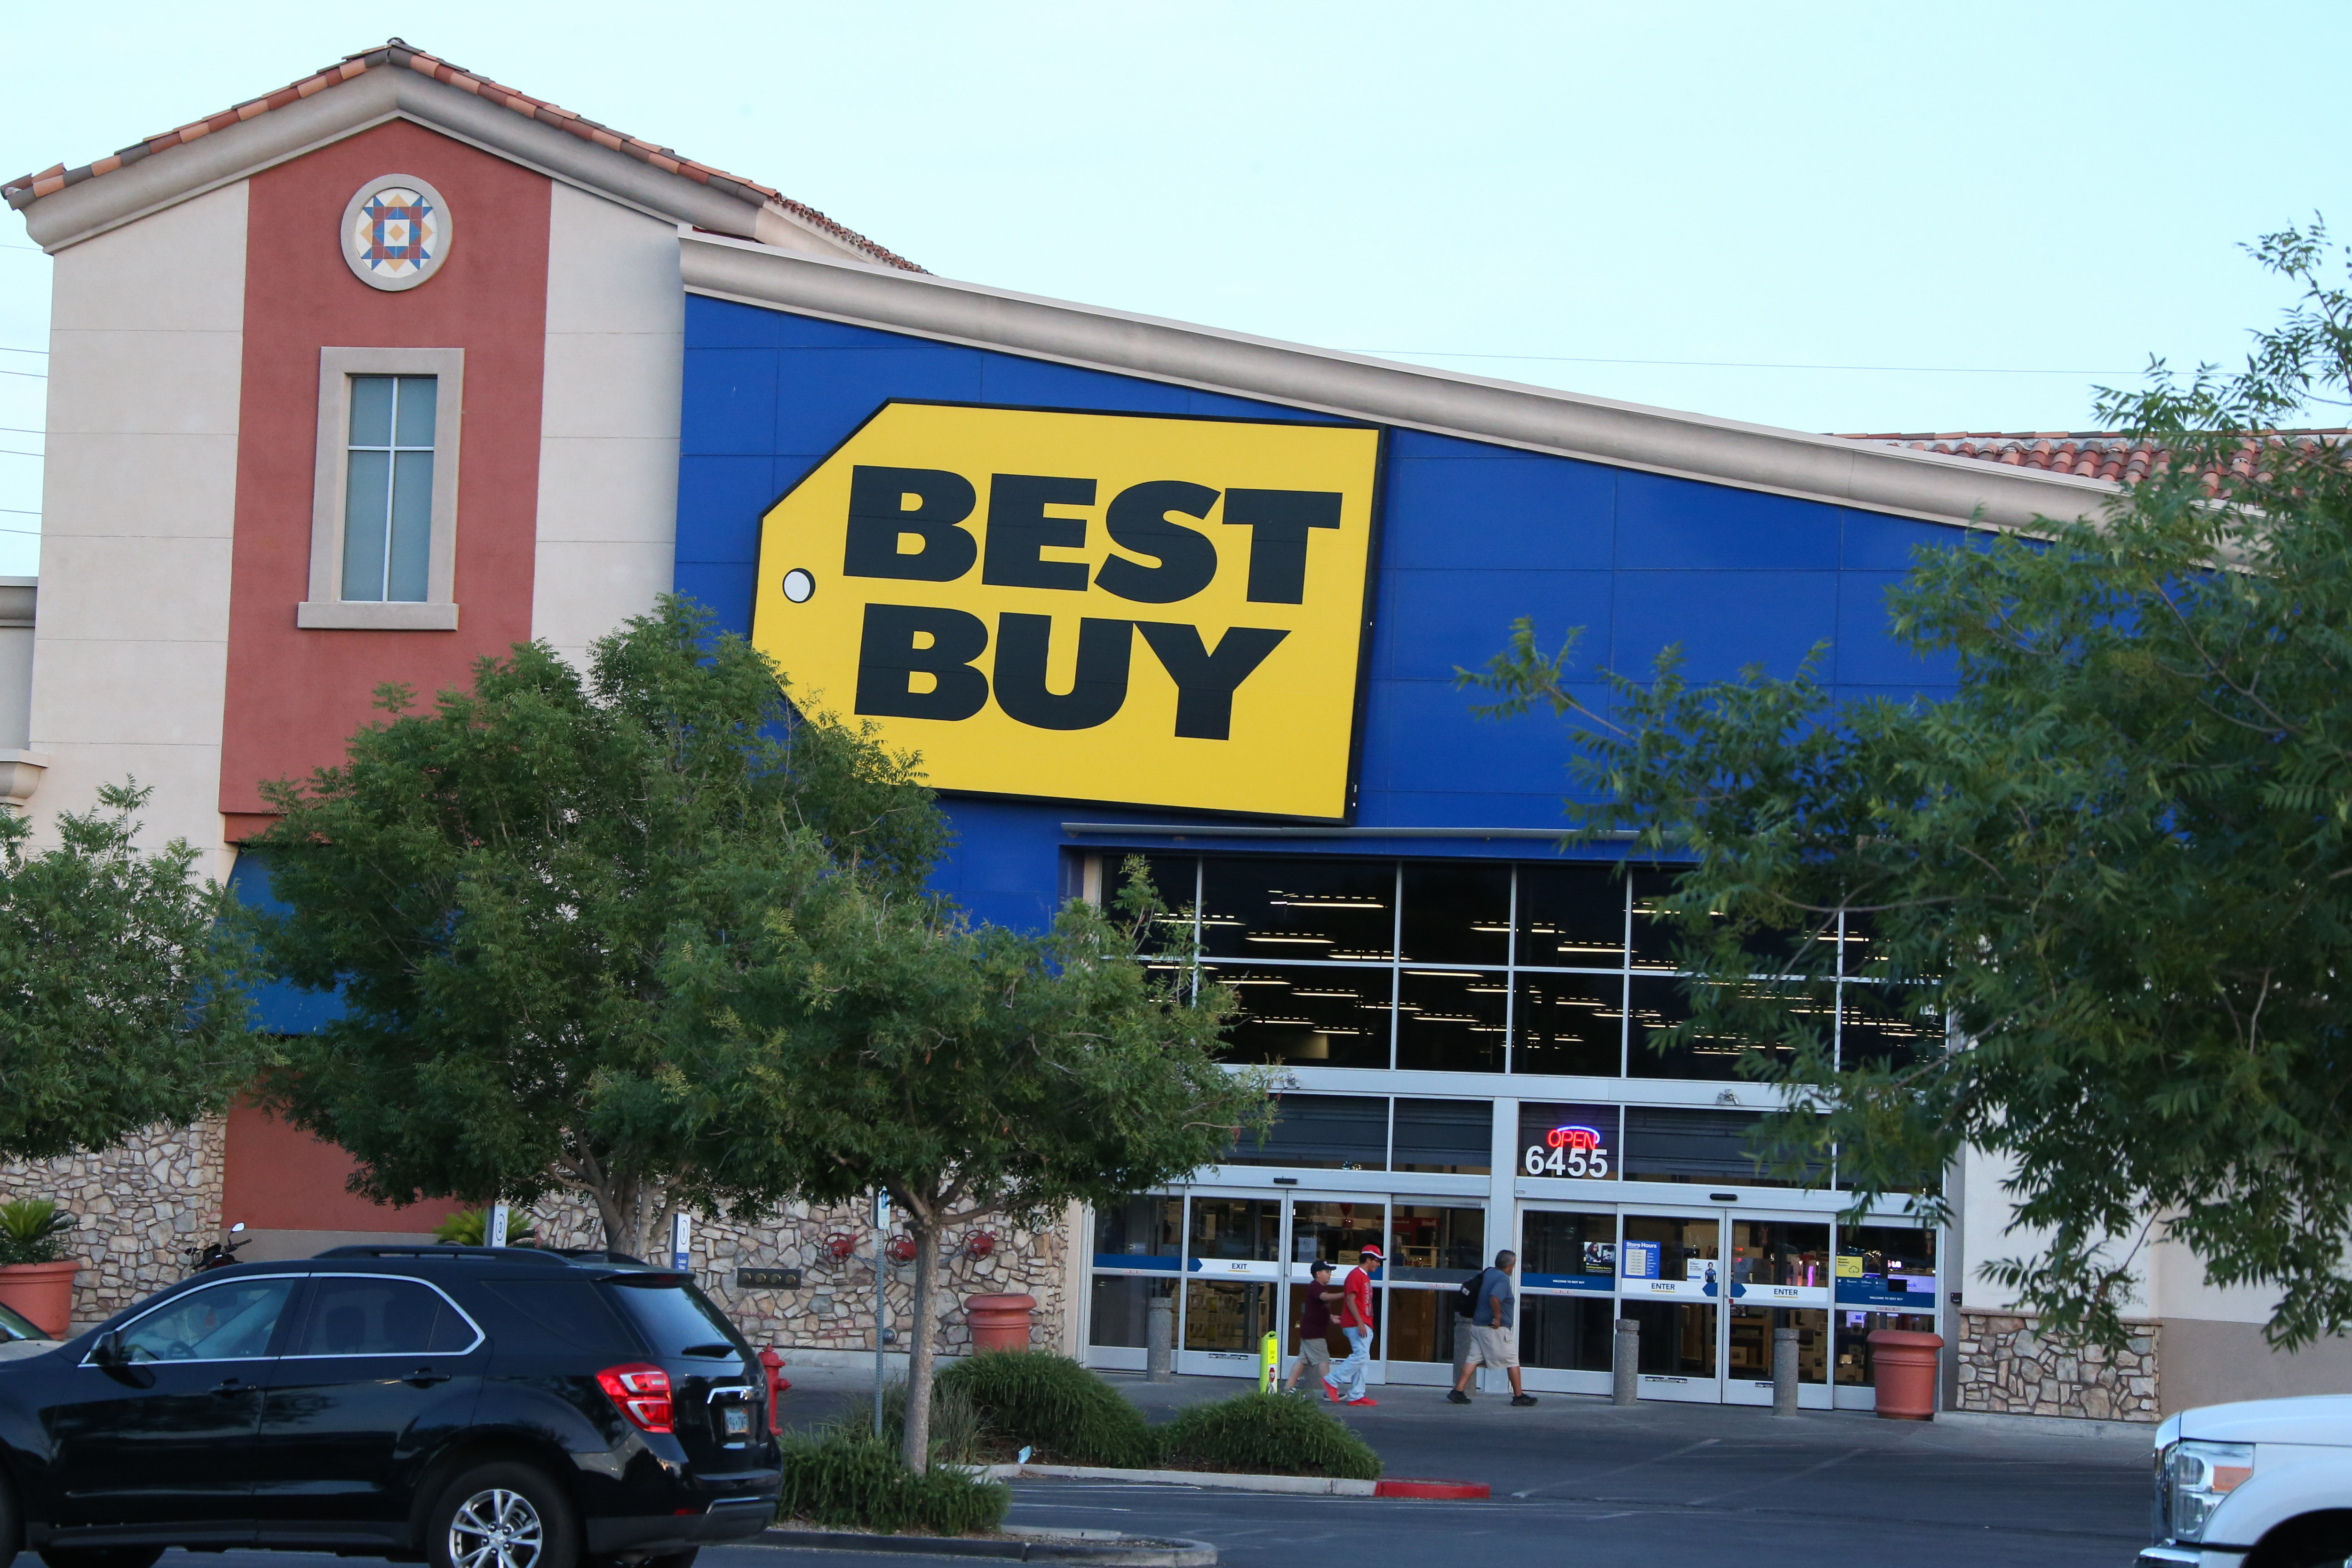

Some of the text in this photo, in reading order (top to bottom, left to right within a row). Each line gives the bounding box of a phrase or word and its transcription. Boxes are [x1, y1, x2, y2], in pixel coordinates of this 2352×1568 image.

[843, 465, 1342, 605] BEST
[854, 603, 1291, 740] BUY
[1548, 1130, 1597, 1150] OPEN
[1526, 1146, 1608, 1178] 6455
[499, 1222, 502, 1234] 3
